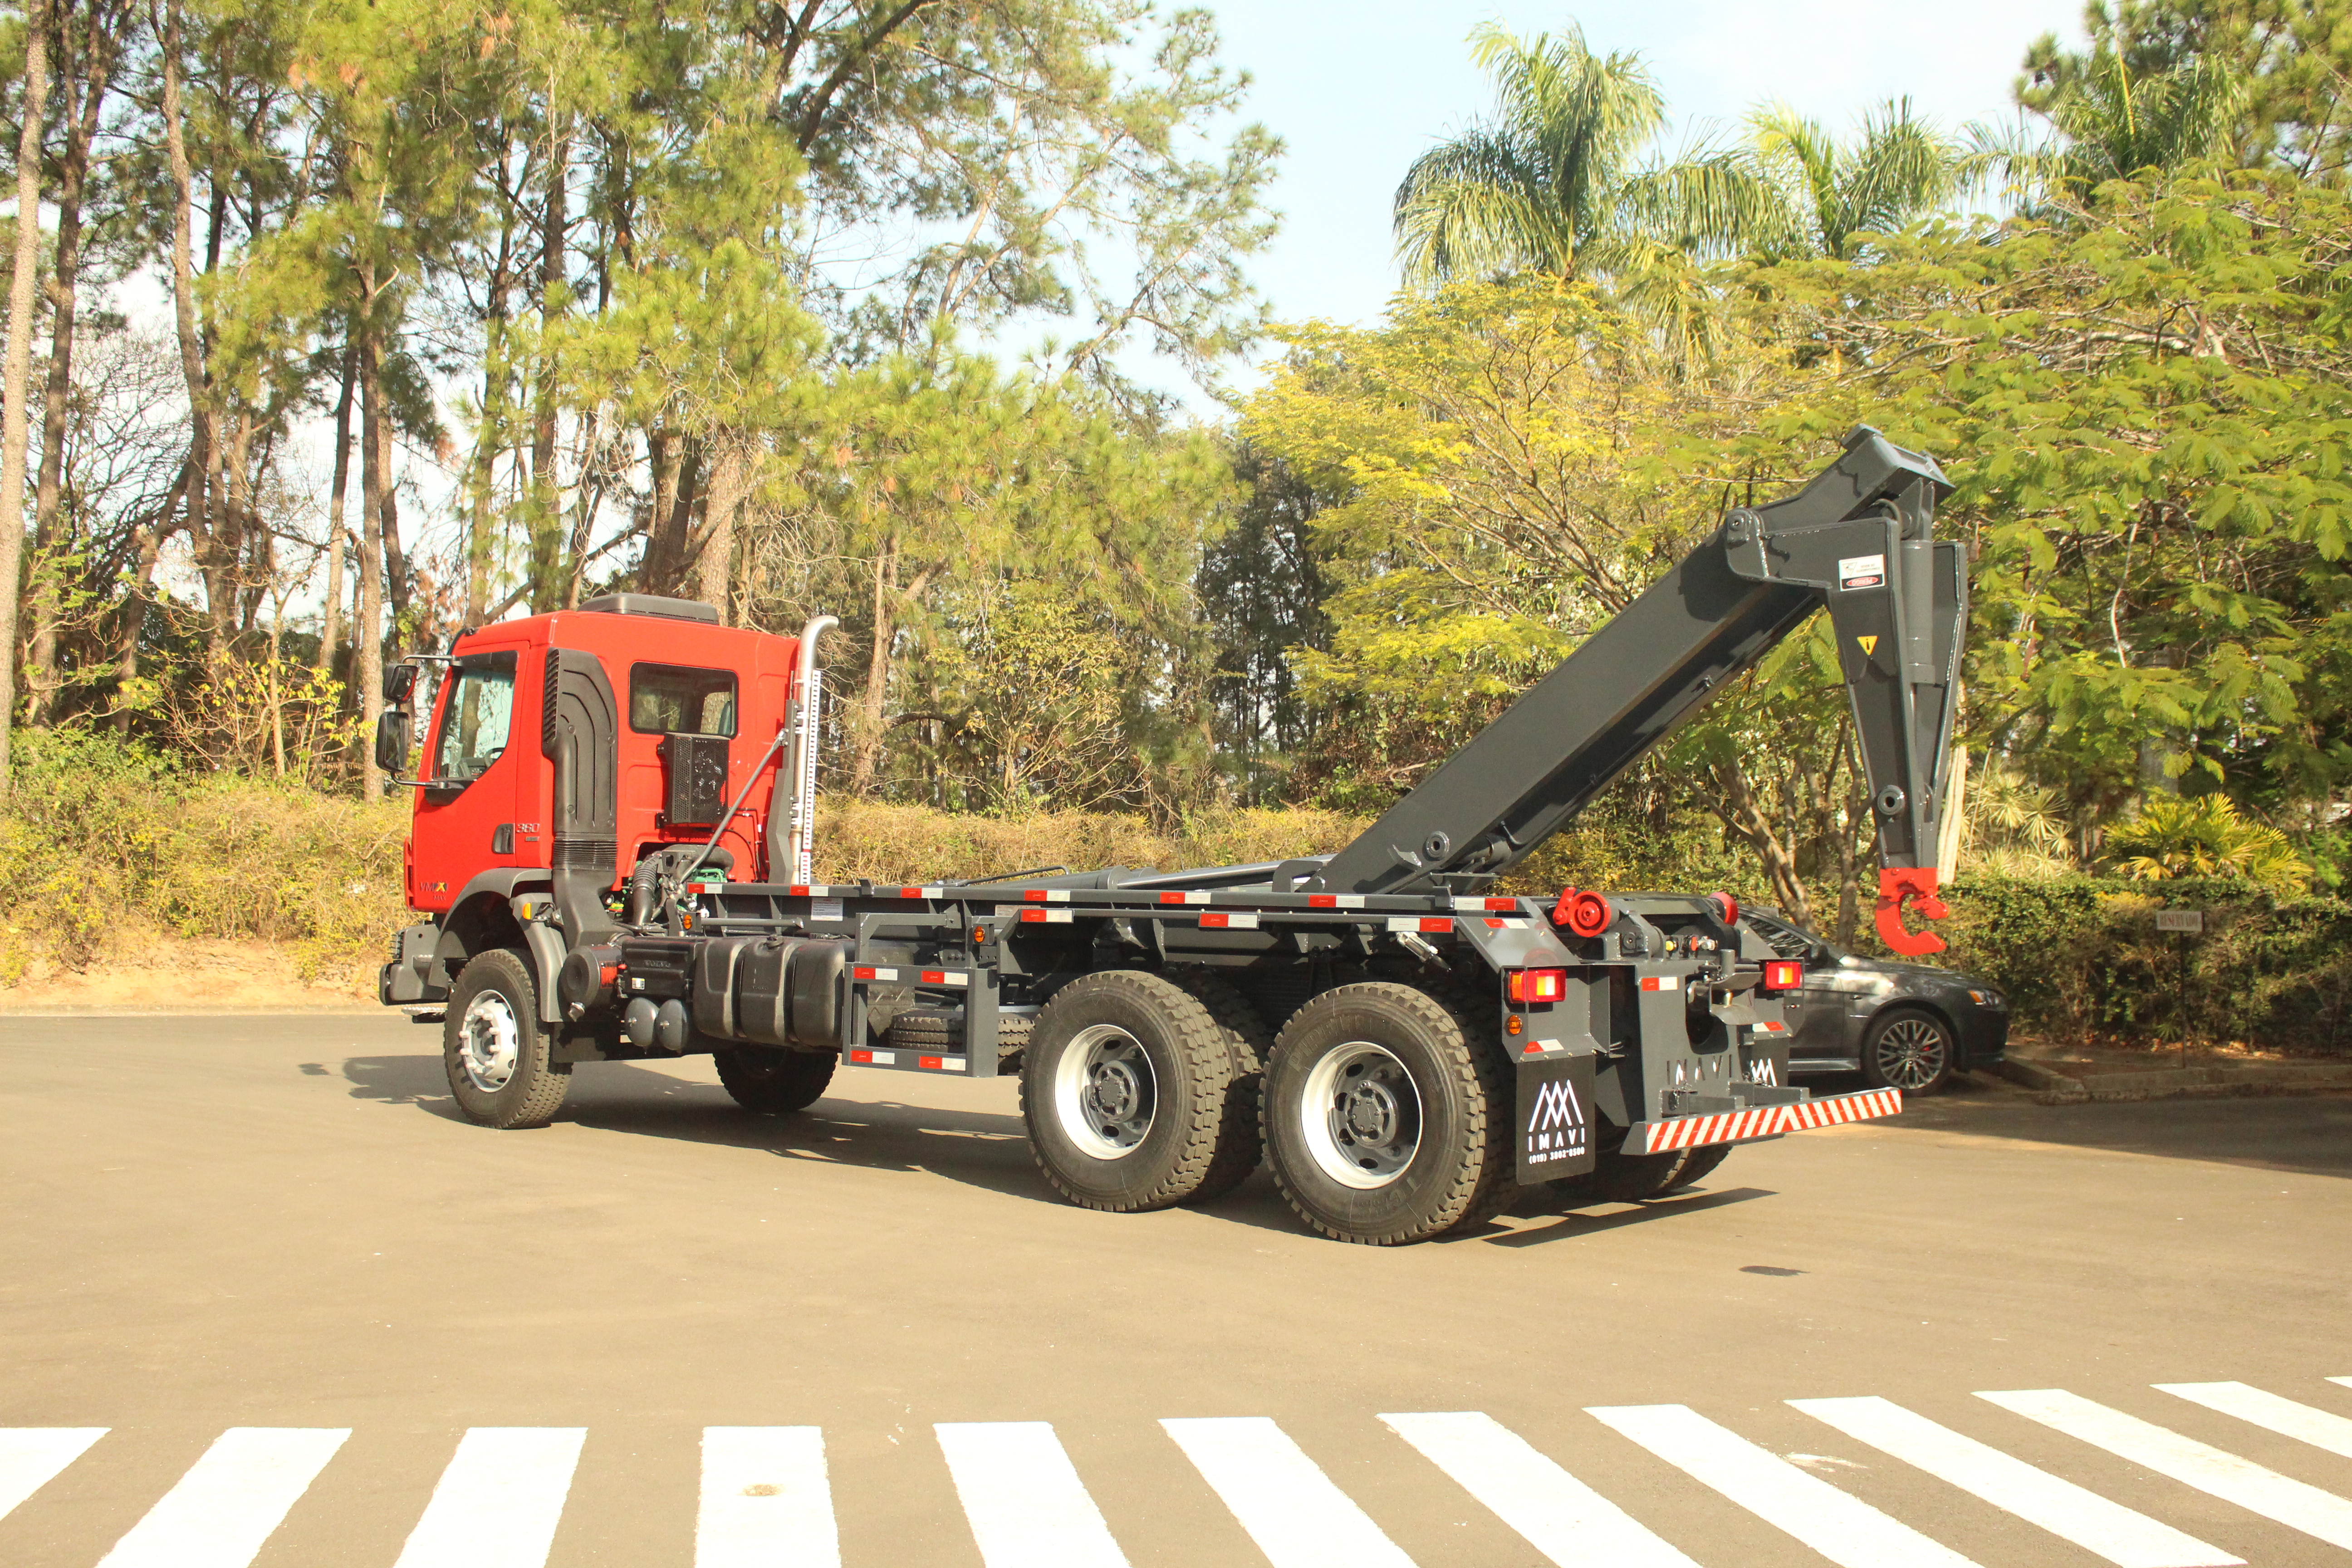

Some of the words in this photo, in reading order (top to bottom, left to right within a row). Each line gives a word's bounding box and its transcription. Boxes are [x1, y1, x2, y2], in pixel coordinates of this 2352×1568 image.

[1852, 578, 1872, 586] PERIGO
[517, 823, 539, 833] 360
[2160, 913, 2198, 927] RESERVADO
[1529, 1127, 1585, 1152] IMAVI
[1529, 1153, 1547, 1164] (019)
